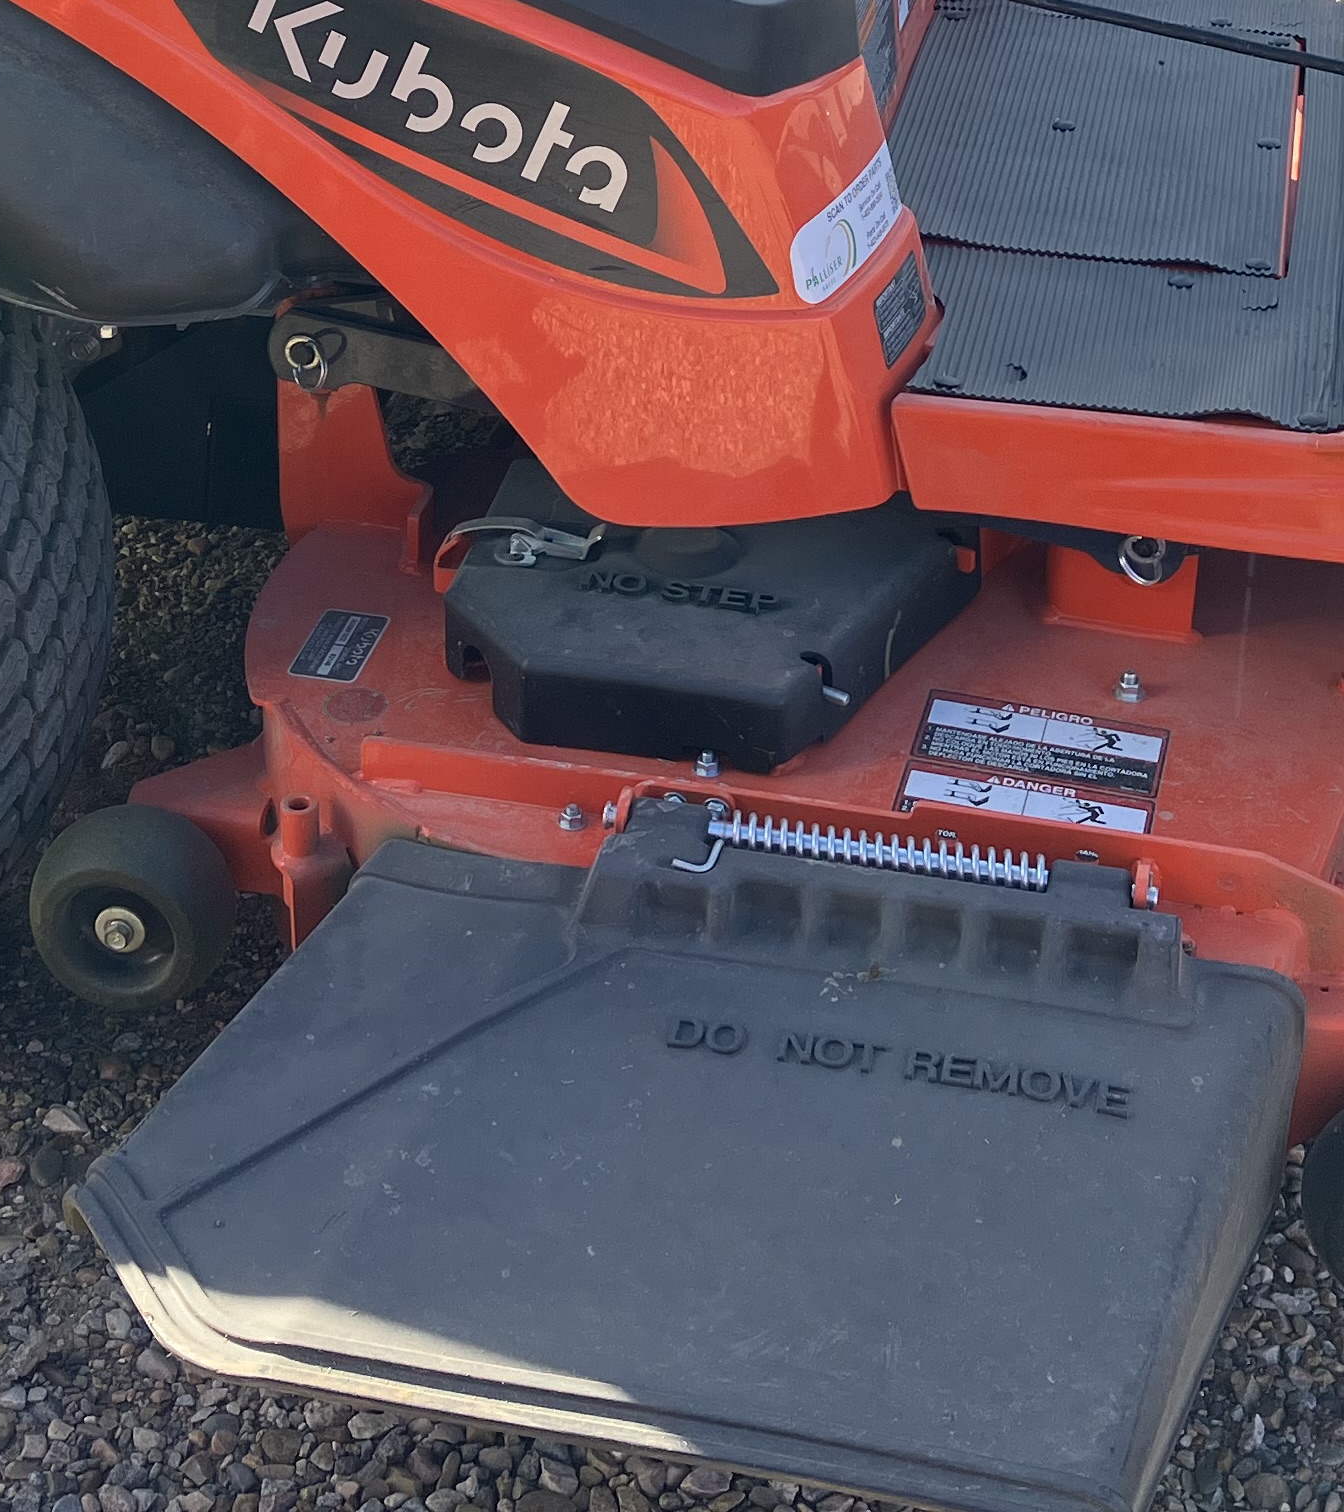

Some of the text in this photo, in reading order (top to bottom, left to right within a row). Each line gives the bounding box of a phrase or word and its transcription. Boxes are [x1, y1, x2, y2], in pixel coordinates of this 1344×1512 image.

[826, 200, 845, 223] SCAN
[843, 192, 853, 207] TO
[851, 174, 869, 199] ORDER
[805, 255, 843, 291] PALLISER
[582, 571, 780, 616] NO STEP
[1019, 705, 1093, 726] PELIGRO
[1002, 777, 1077, 798] DANGER
[667, 1019, 1132, 1120] DO NOT REMOVE
